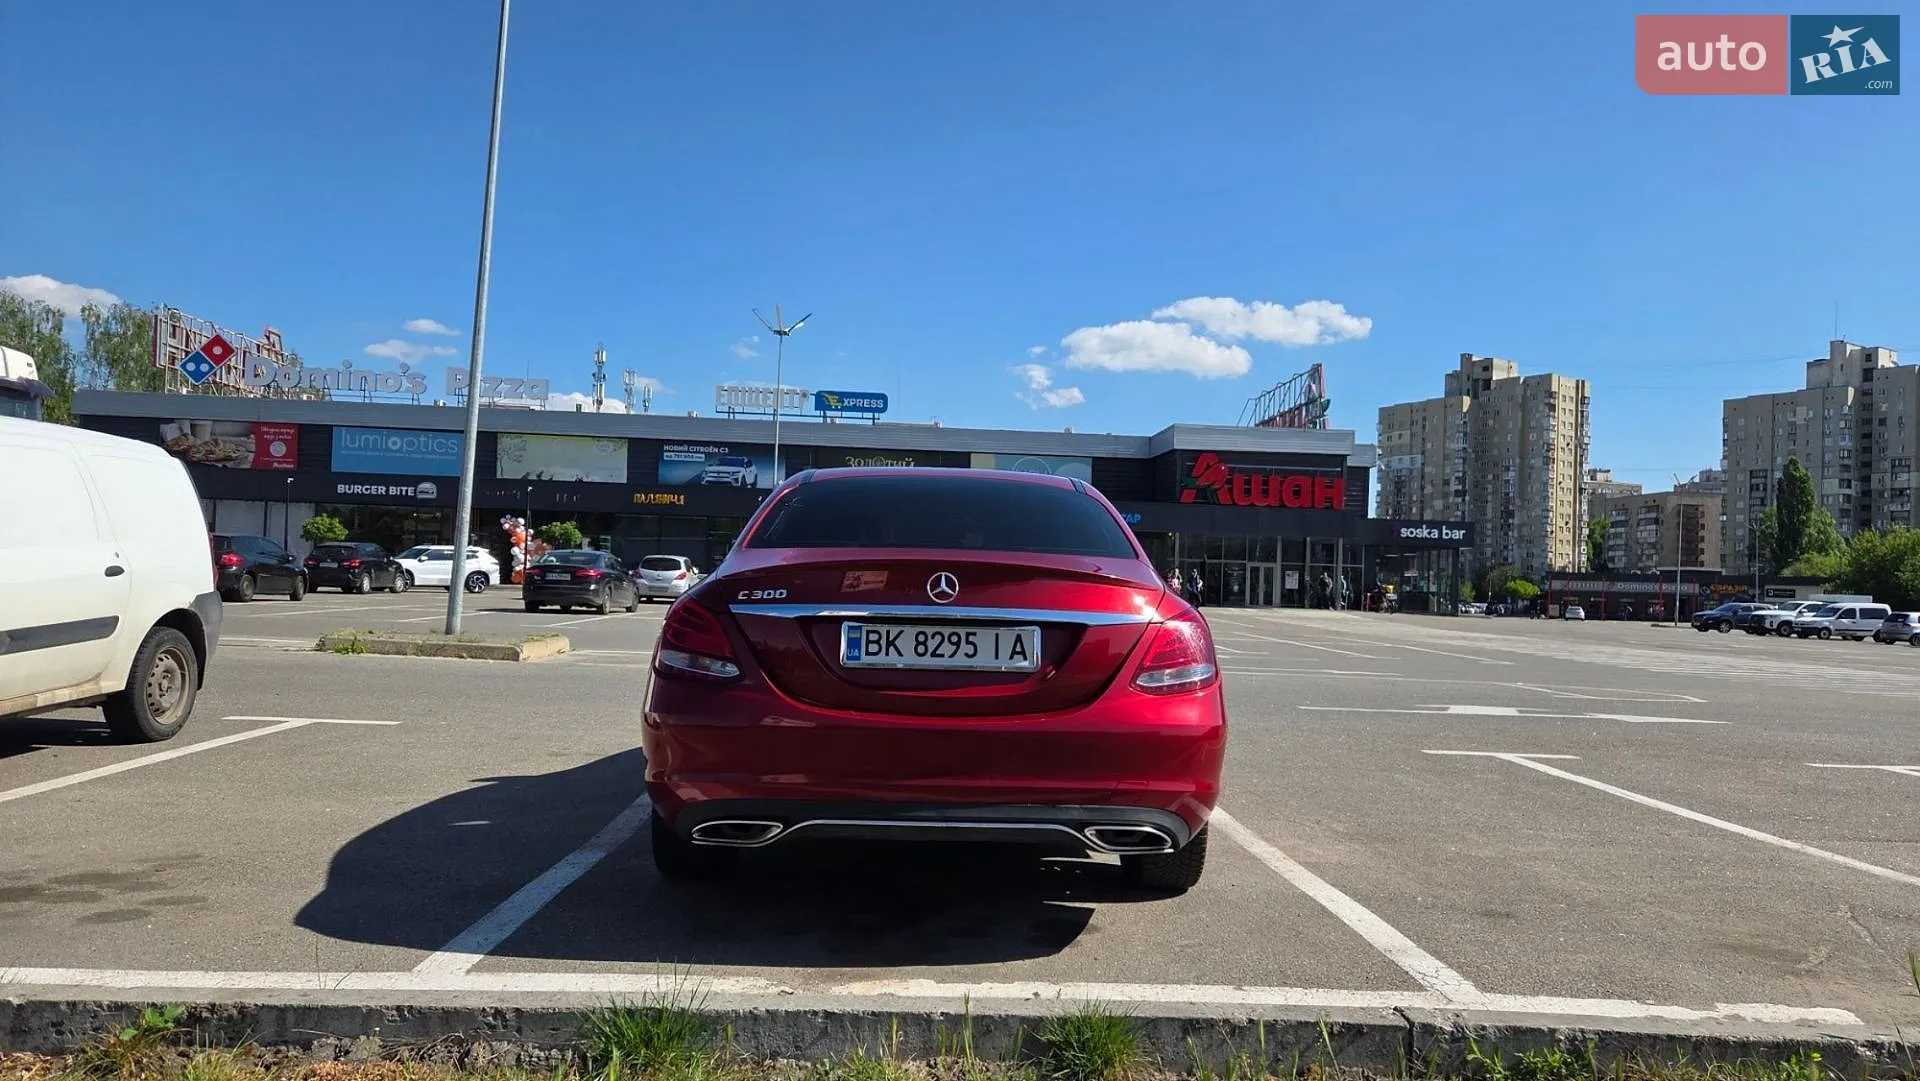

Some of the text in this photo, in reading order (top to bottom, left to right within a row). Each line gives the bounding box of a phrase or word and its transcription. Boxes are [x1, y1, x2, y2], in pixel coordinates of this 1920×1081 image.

[246, 357, 429, 395] Domino's
[341, 427, 459, 454] lumioptics
[337, 484, 415, 496] BURGER BITE
[1400, 523, 1466, 540] soska bar
[847, 649, 860, 657] UA
[864, 629, 905, 658] BK
[913, 631, 979, 659] 8295
